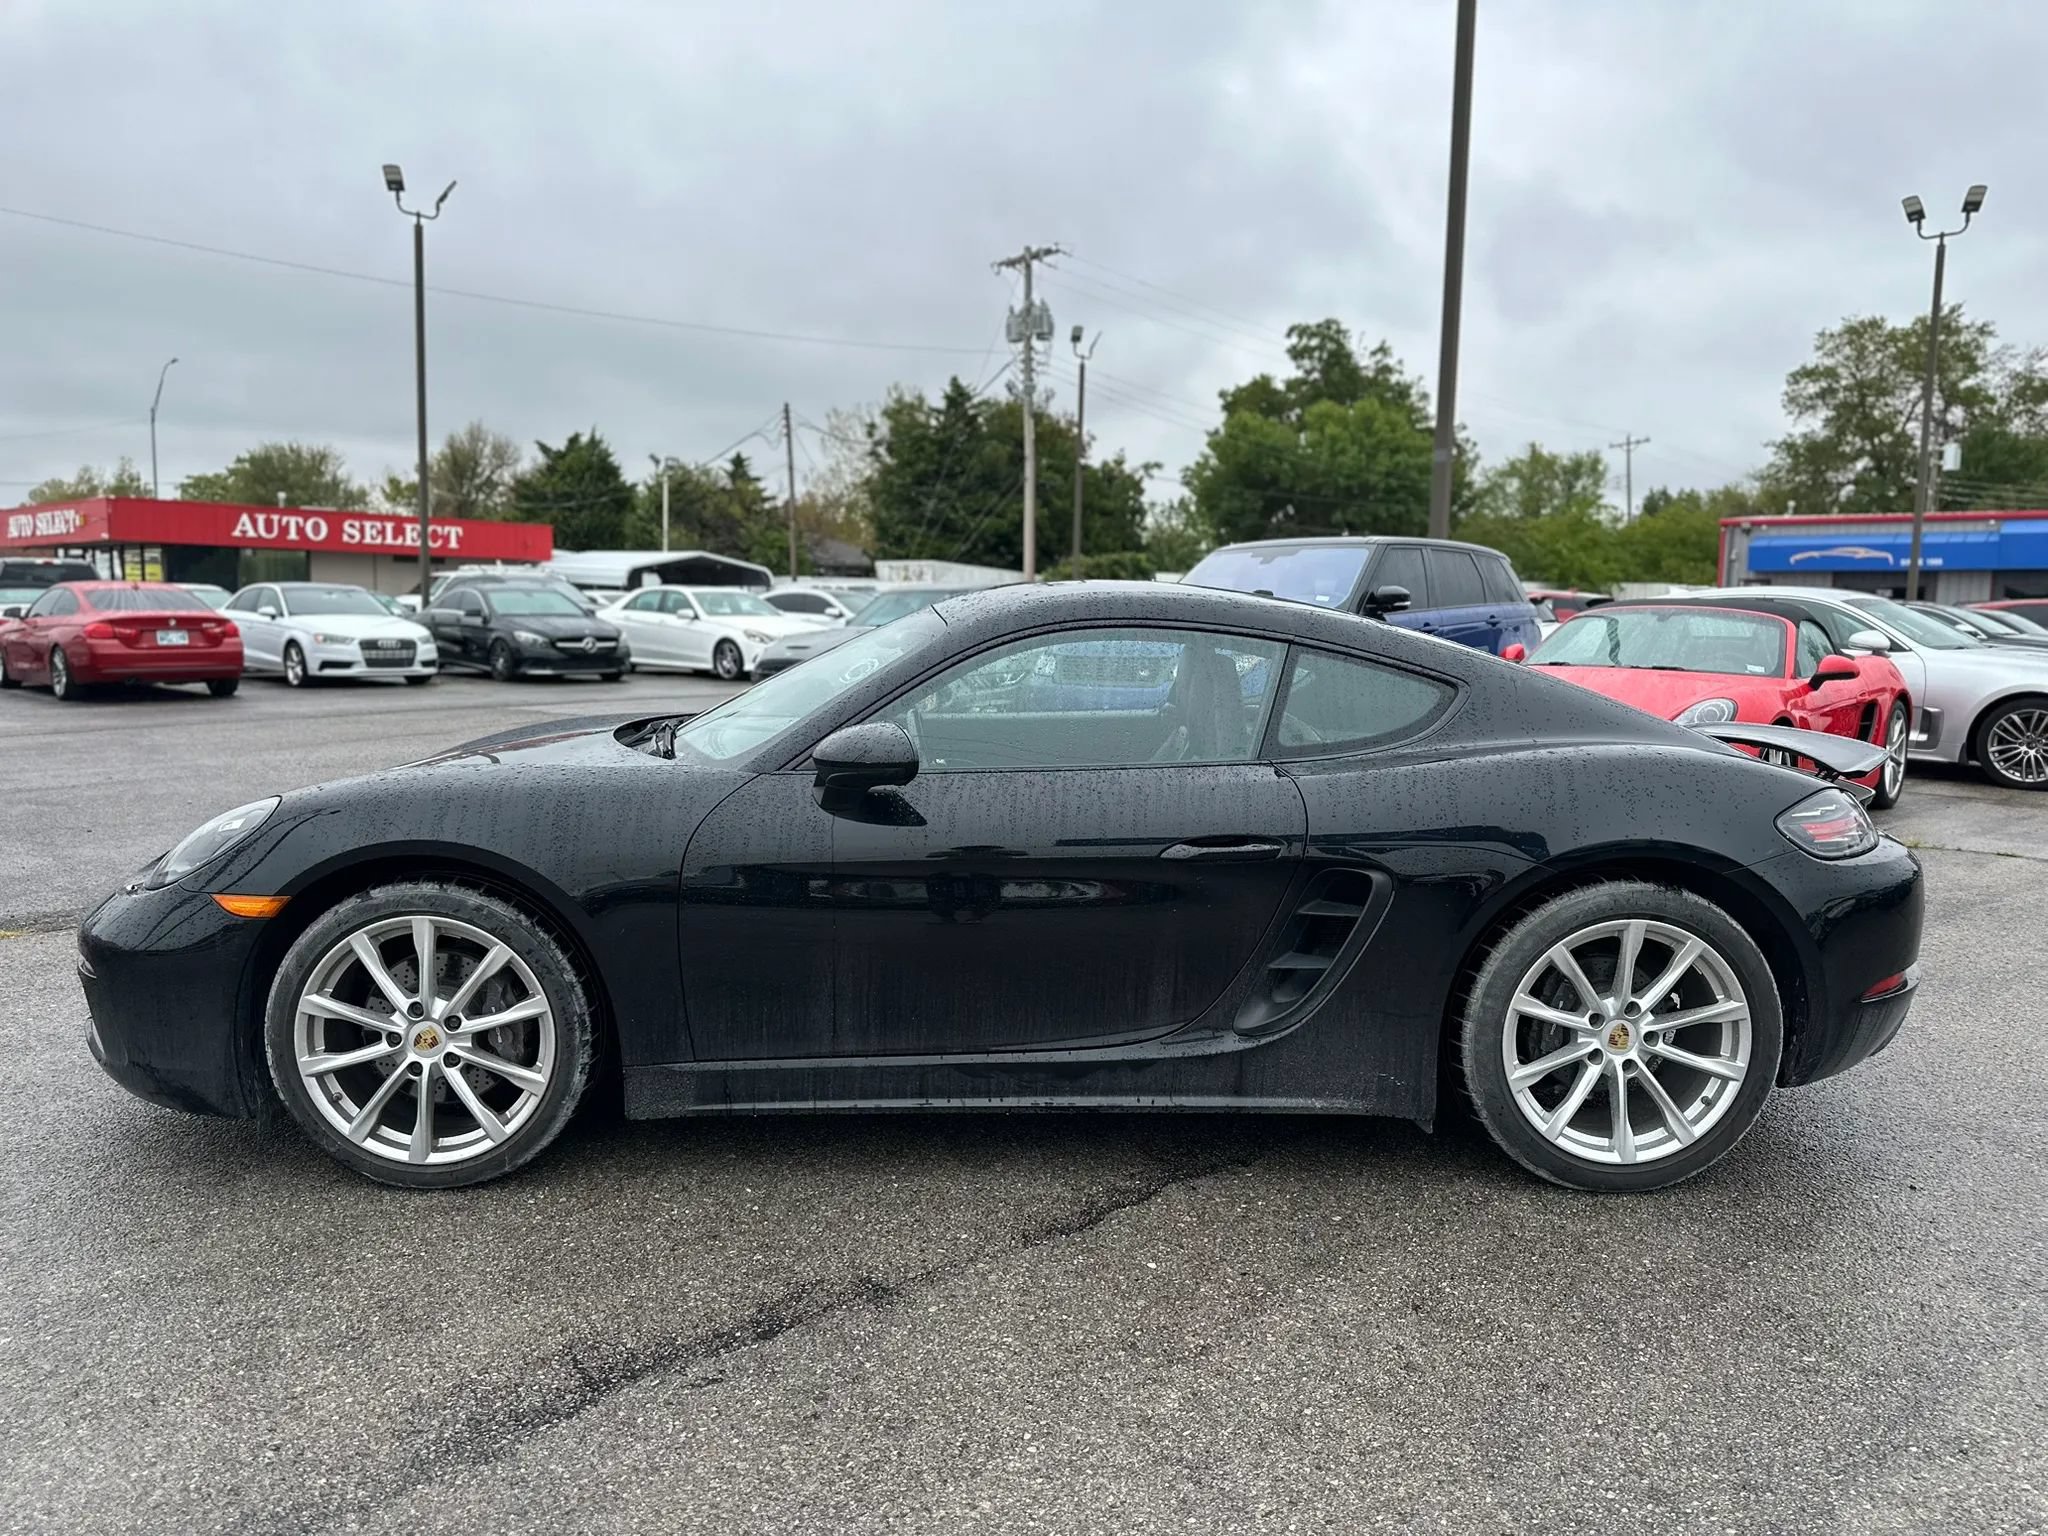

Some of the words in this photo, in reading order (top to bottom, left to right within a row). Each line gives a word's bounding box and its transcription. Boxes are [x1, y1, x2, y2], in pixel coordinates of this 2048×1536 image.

[35, 509, 76, 536] SELECT
[231, 512, 329, 541] AUTO
[342, 519, 464, 549] SELECT
